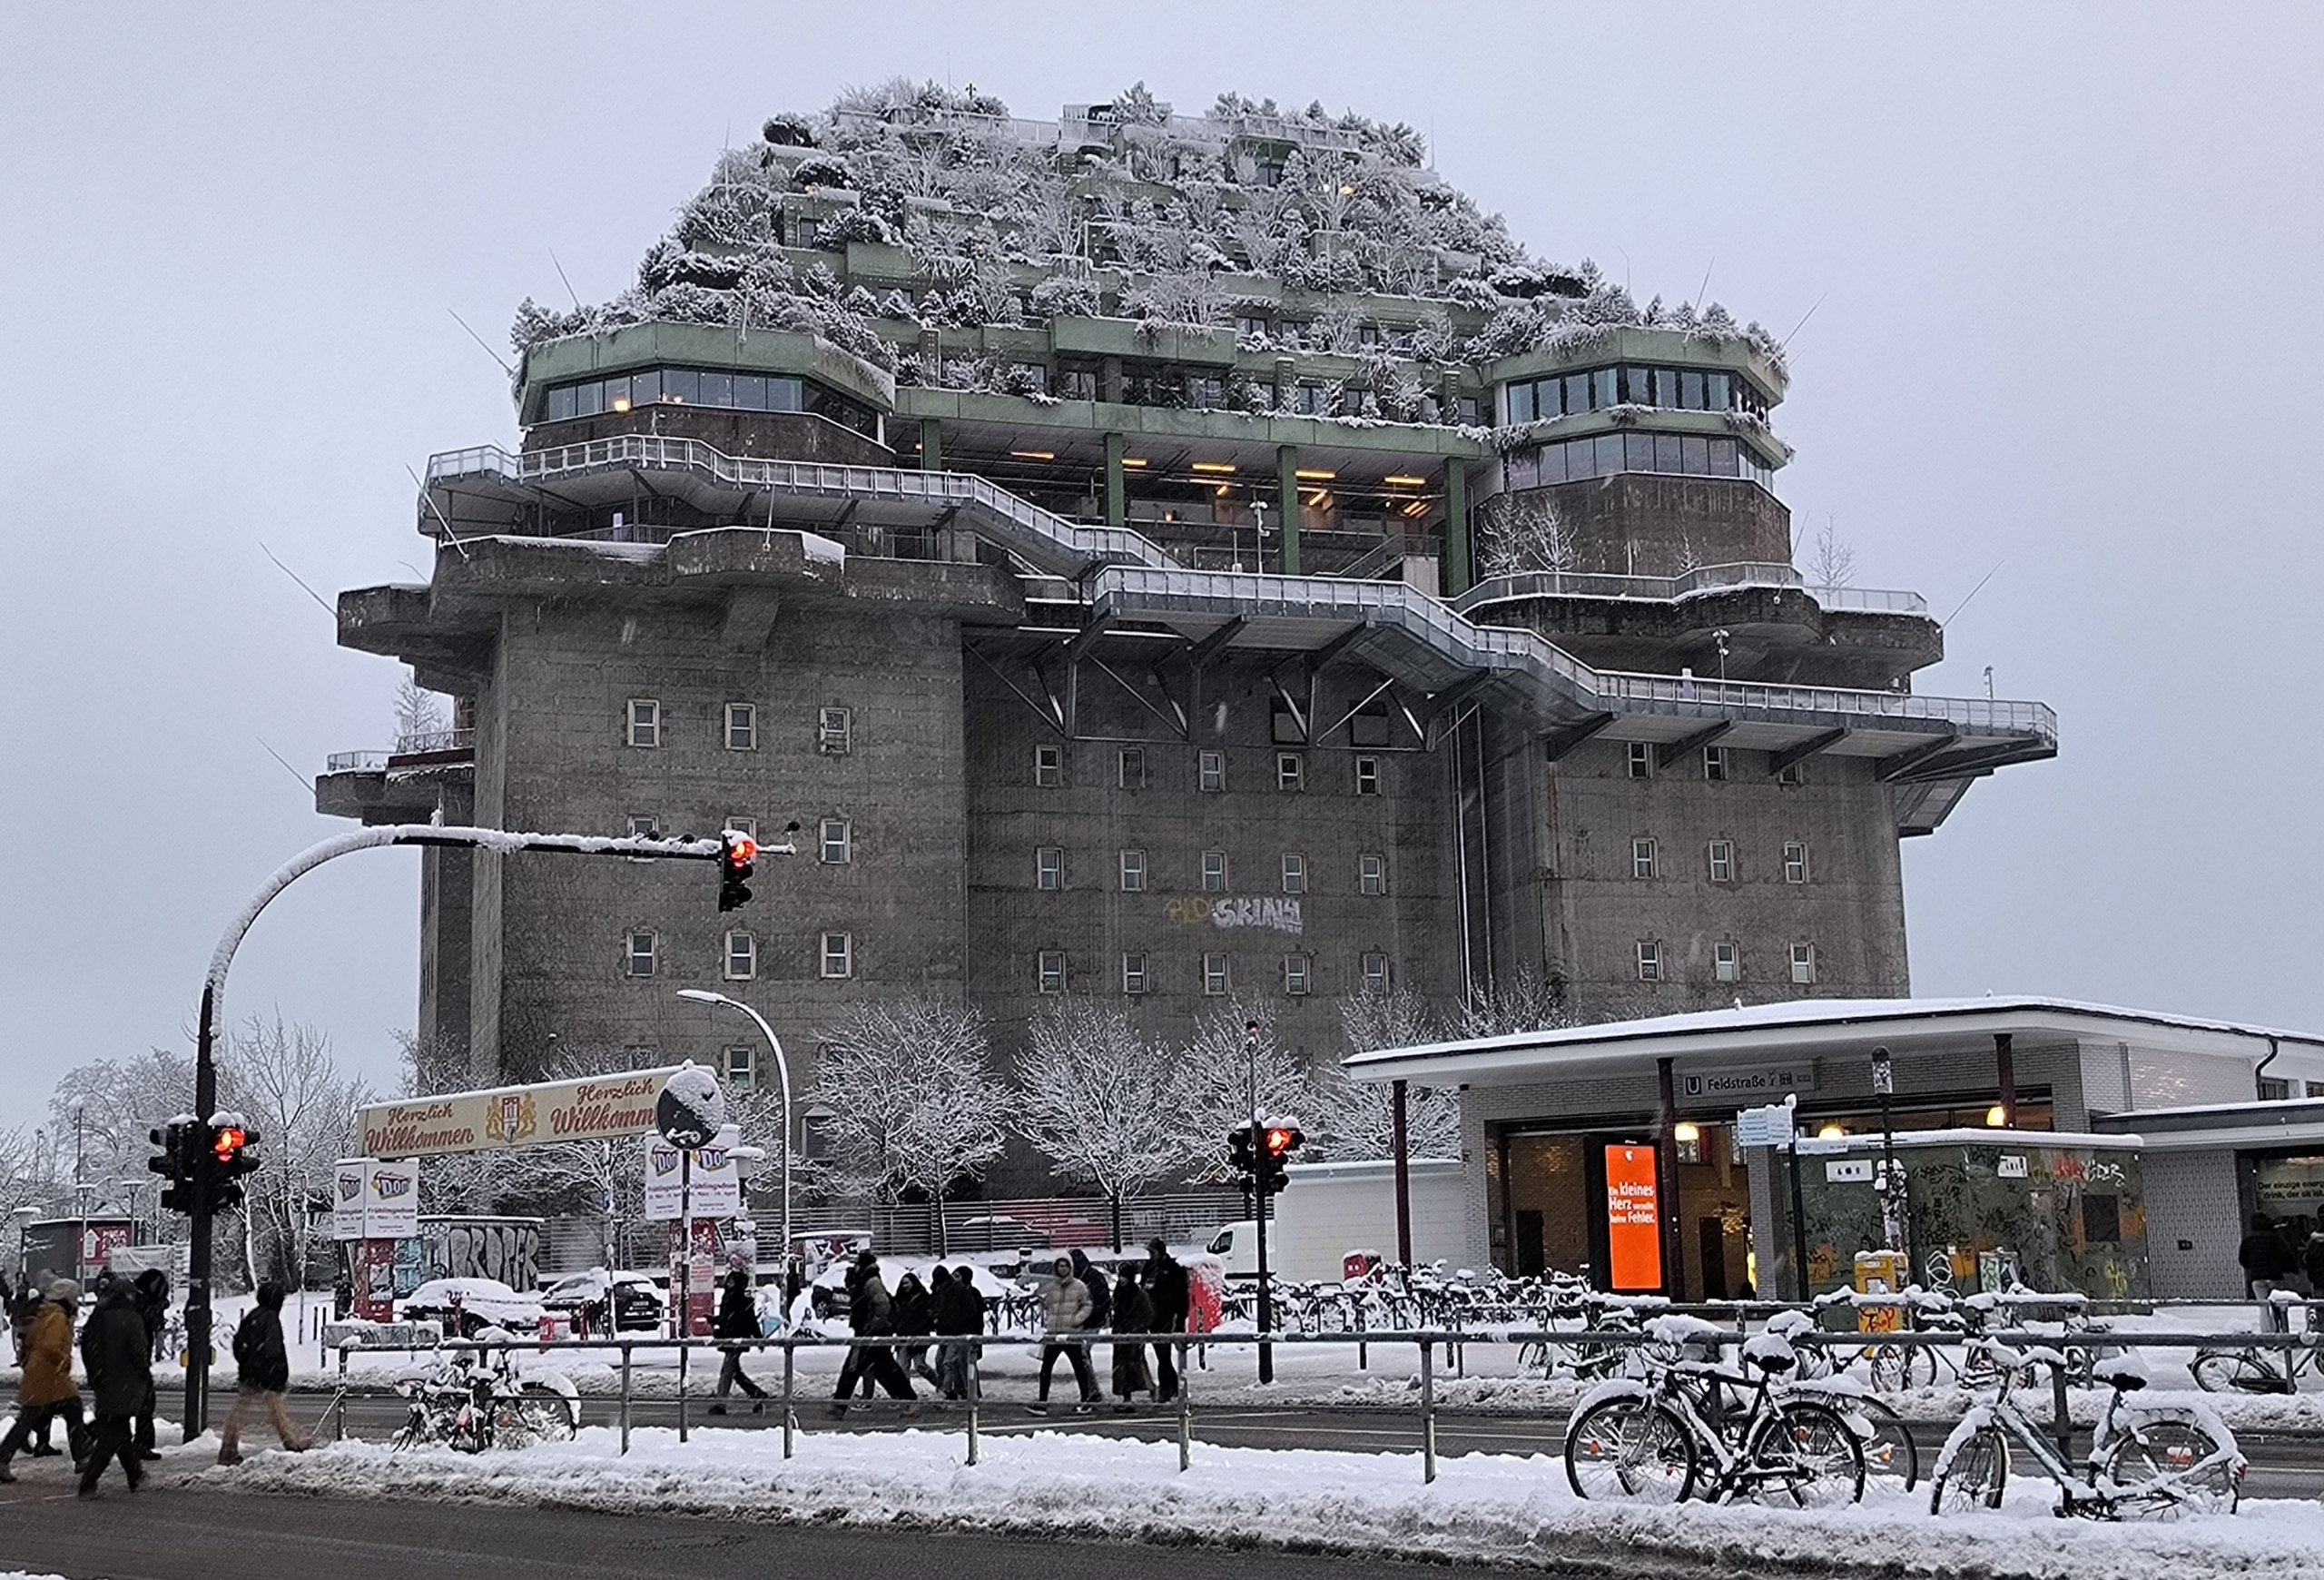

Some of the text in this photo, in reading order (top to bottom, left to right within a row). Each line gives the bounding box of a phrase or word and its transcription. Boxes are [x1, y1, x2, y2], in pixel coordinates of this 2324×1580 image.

[1708, 1075, 1766, 1090] Feldstraße
[576, 1078, 655, 1106] Herzlich
[388, 1102, 453, 1127] Herzlich
[550, 1102, 655, 1135] Willkomm
[366, 1124, 475, 1153] Willkommen
[1620, 1181, 1654, 1196] kleines
[2258, 1181, 2271, 1190] Der
[2273, 1180, 2300, 1190] einzige
[2287, 1190, 2299, 1198] der
[1609, 1196, 1632, 1210] Herz
[1628, 1210, 1656, 1223] Fehler.
